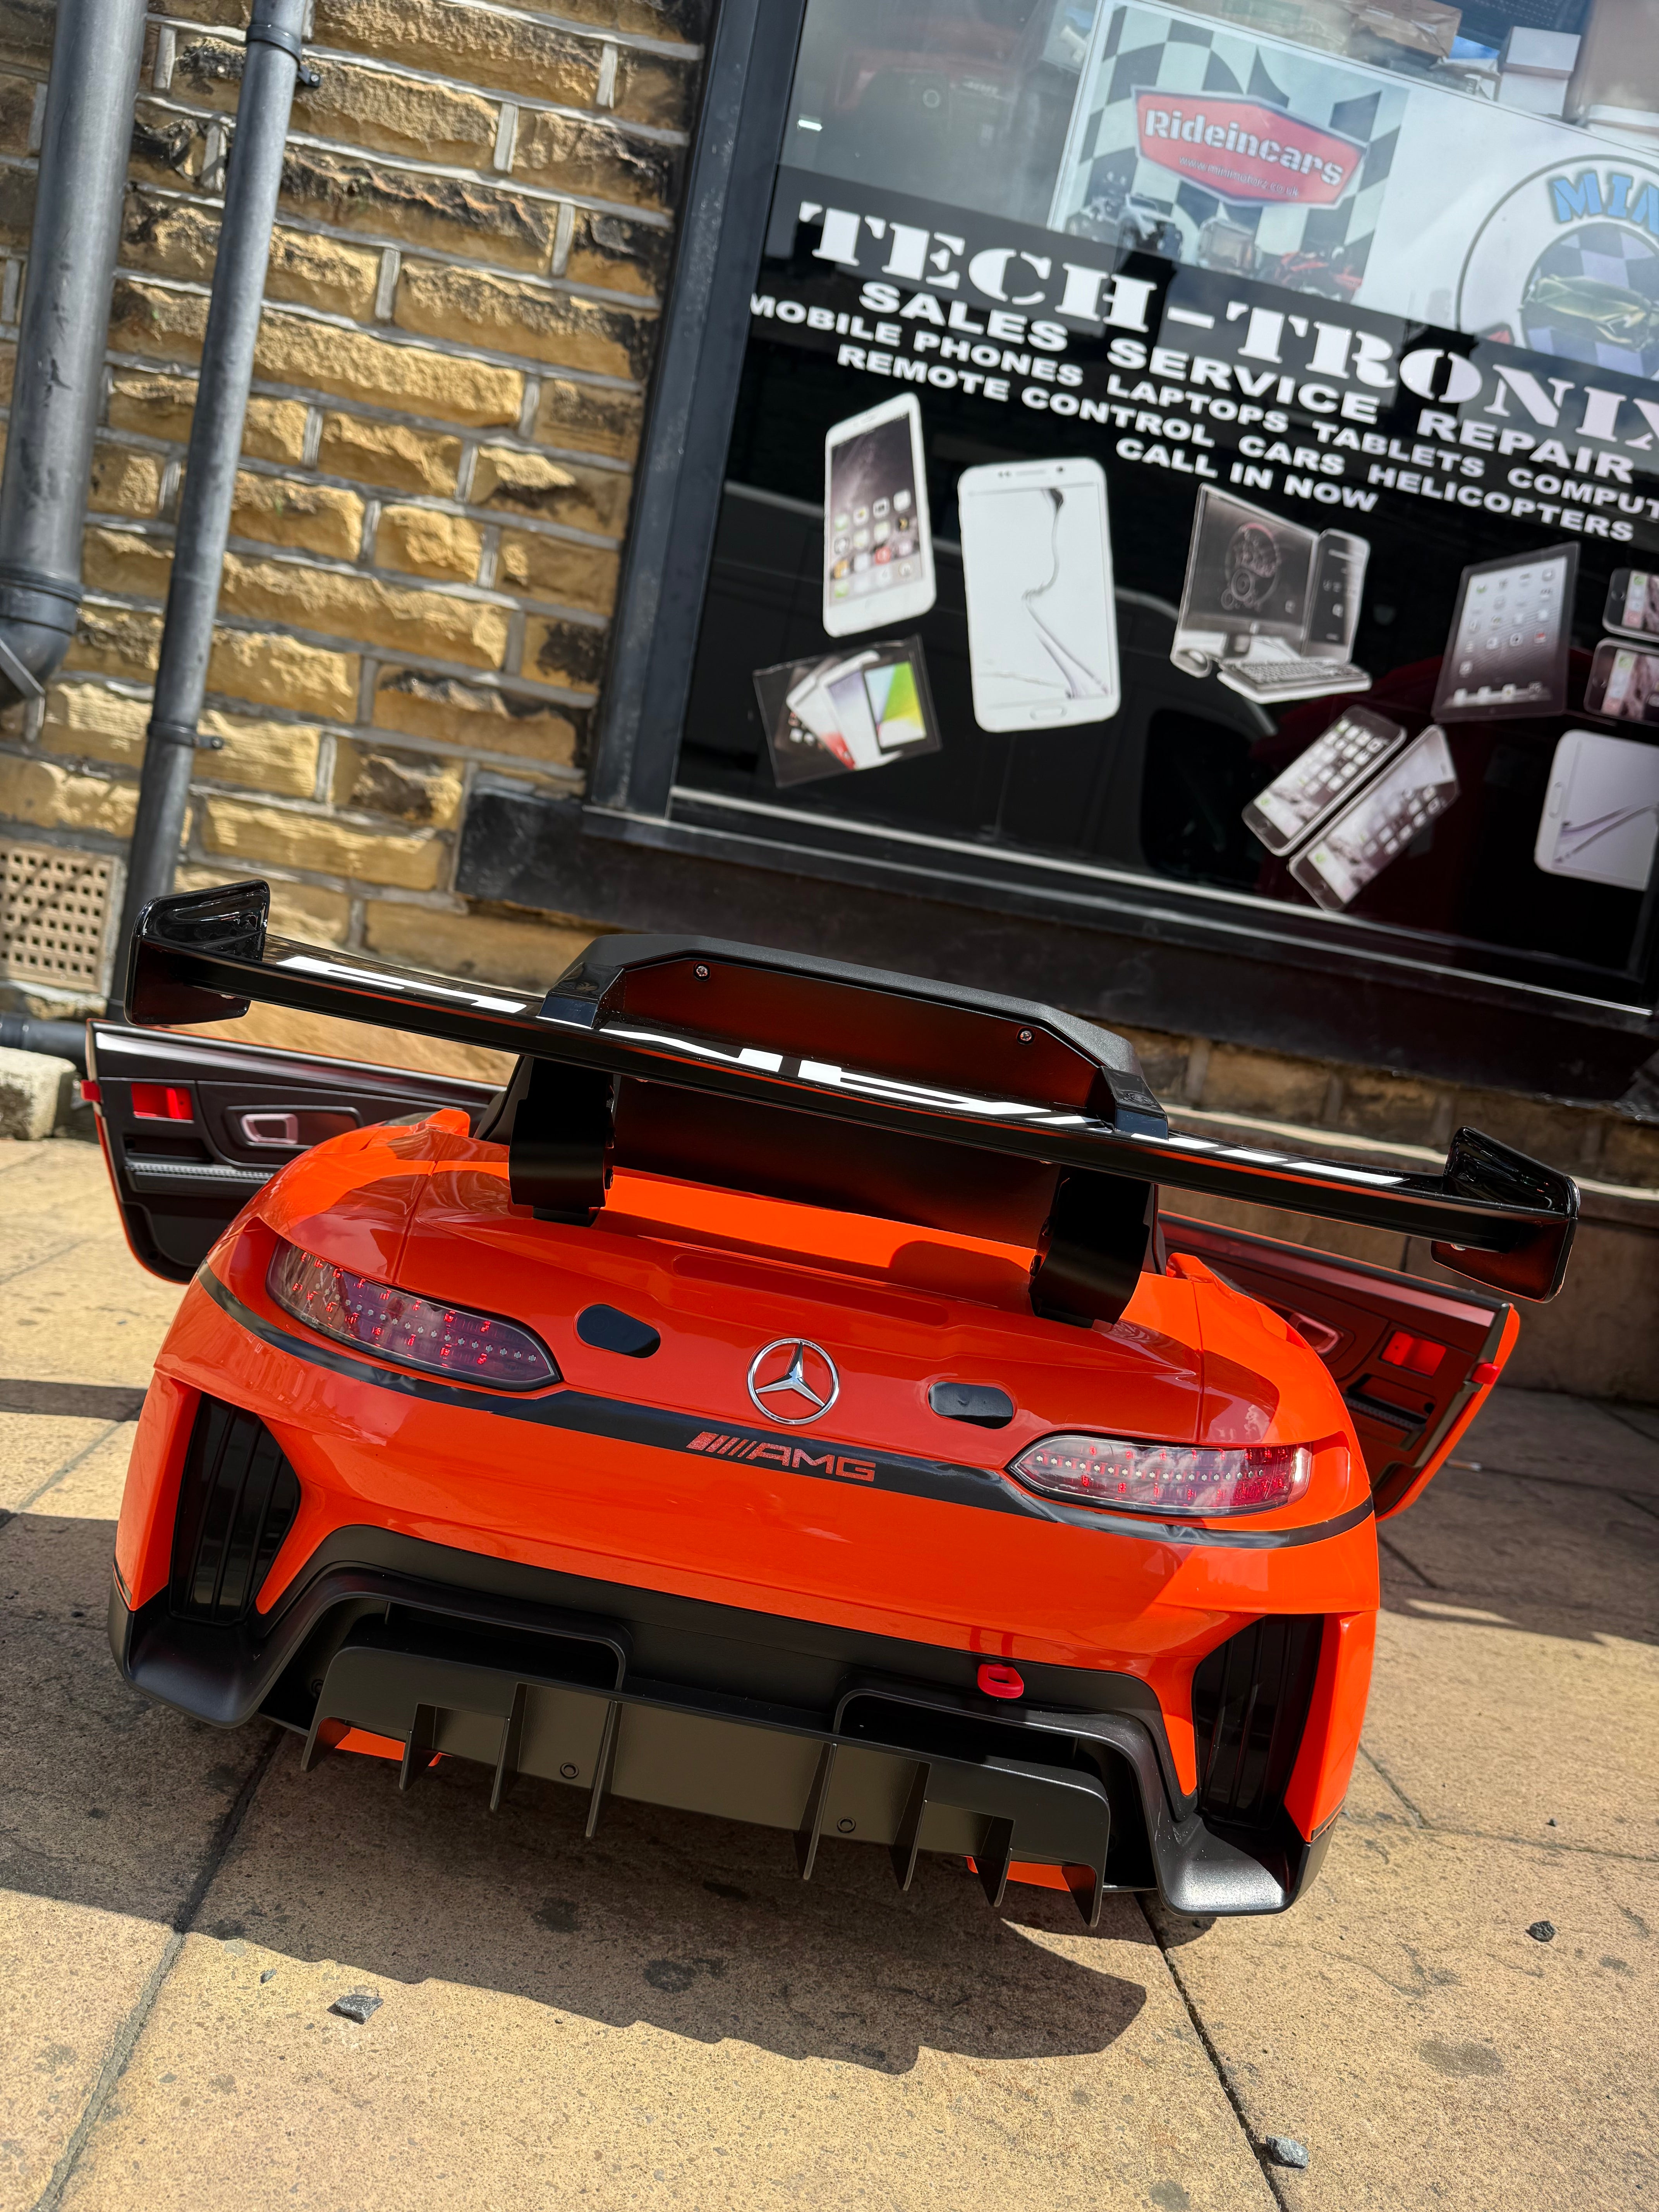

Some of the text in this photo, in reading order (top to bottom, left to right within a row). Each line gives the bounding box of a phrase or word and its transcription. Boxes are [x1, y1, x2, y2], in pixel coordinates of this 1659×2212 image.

[1145, 108, 1344, 186] Rideincars
[750, 292, 902, 347] MOBILE
[913, 331, 1083, 386] PHONES
[1107, 374, 1288, 433] LAPTOPS
[1312, 421, 1484, 477] TABLETS
[837, 344, 1633, 541] REMOTE CONTROL CARS HELICOPTERS
[859, 282, 1634, 483] SALES SERVICE REPAIR
[1116, 439, 1378, 512] CALL IN NOW
